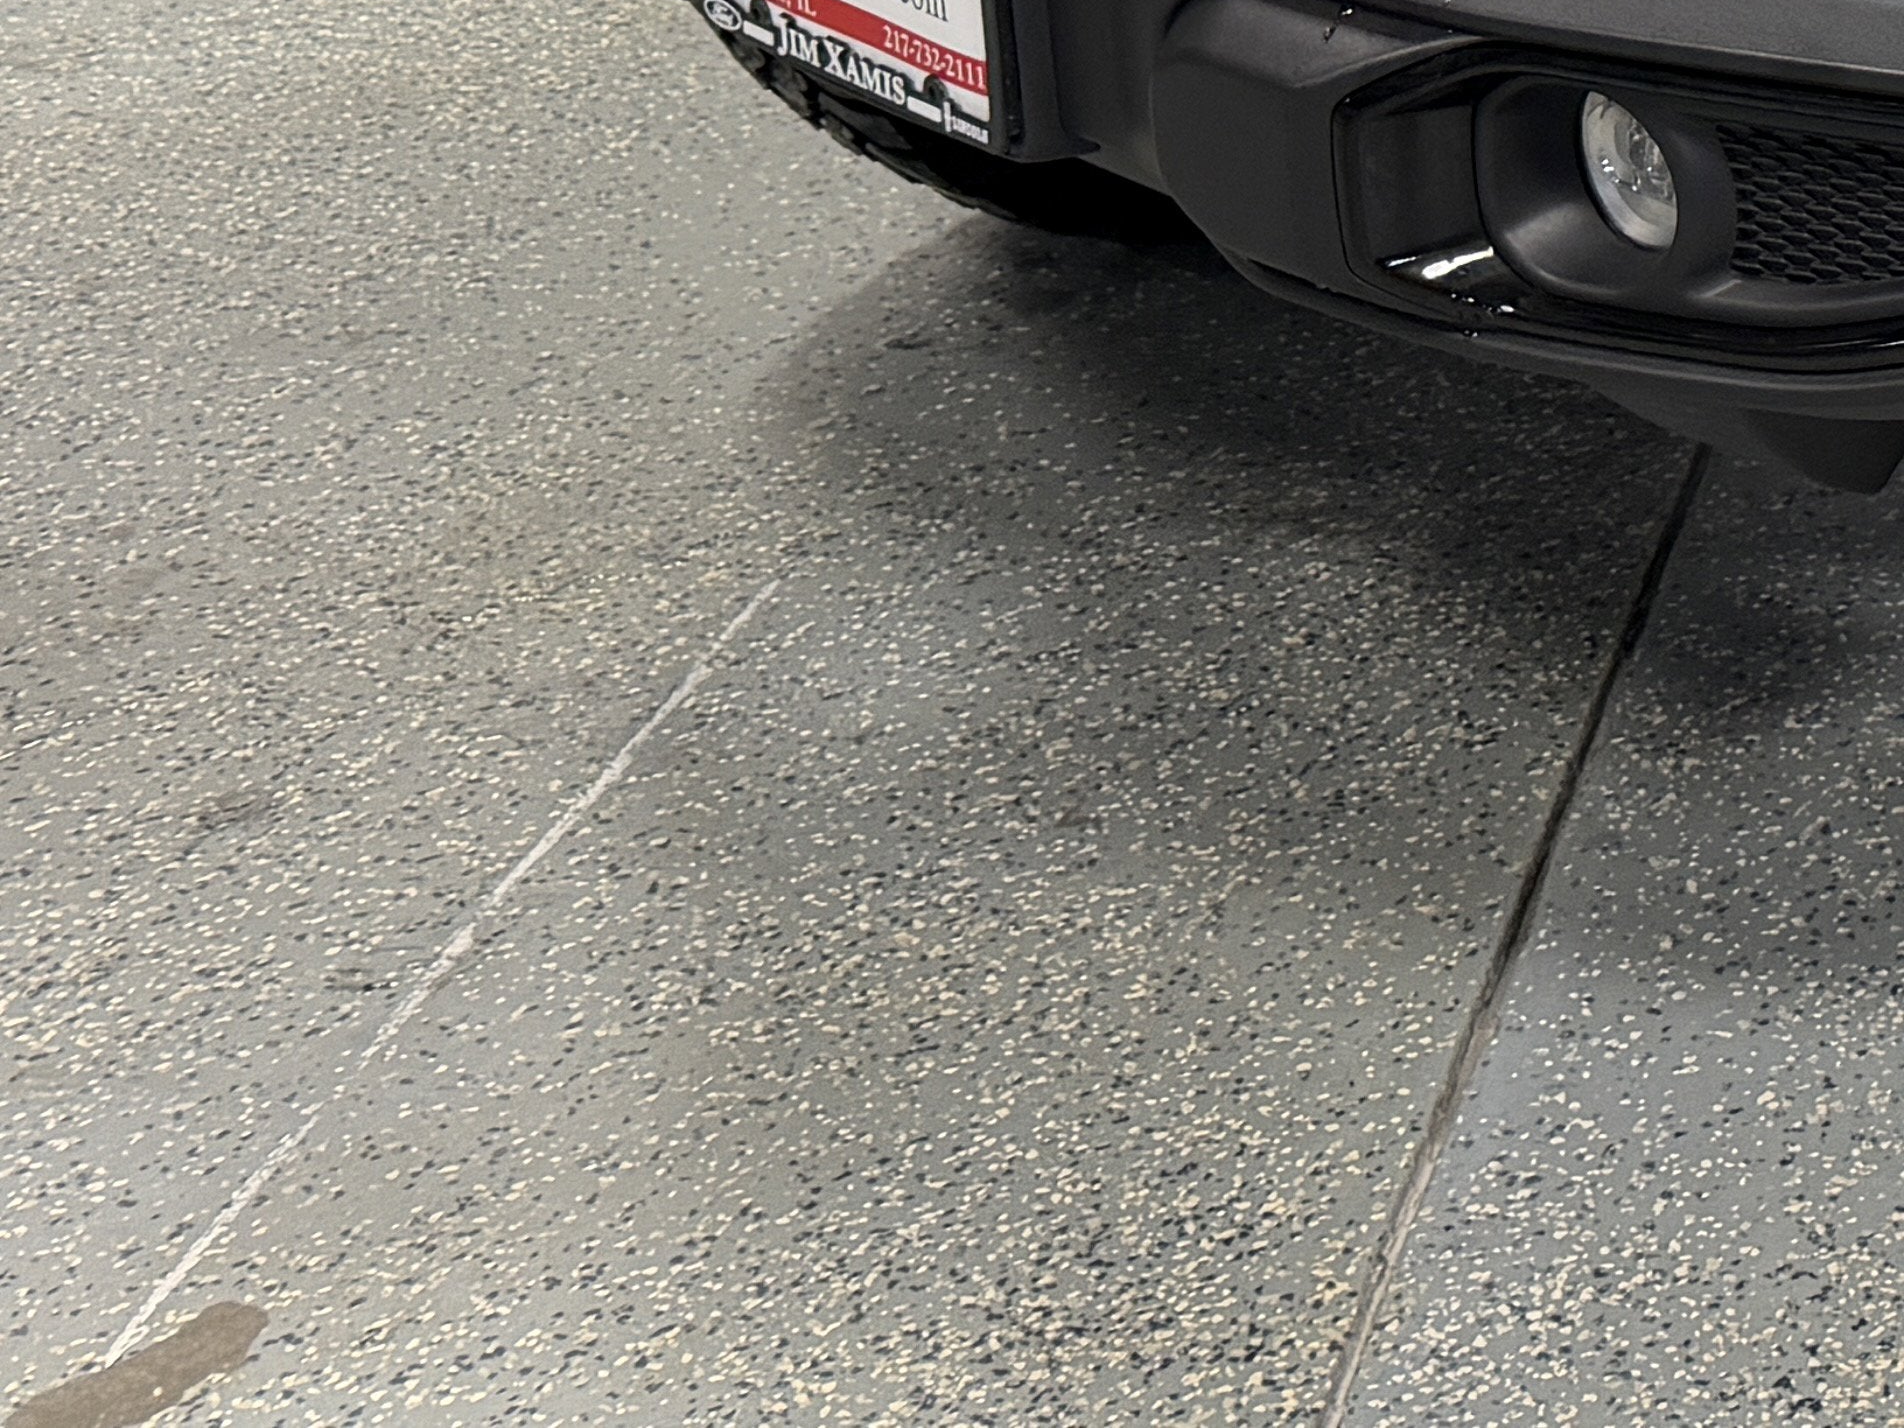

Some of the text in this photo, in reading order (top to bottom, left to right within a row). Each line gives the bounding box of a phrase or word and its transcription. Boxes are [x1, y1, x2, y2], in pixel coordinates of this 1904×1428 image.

[777, 15, 906, 105] JIM XAMIS
[882, 24, 988, 90] 217-732-2111
